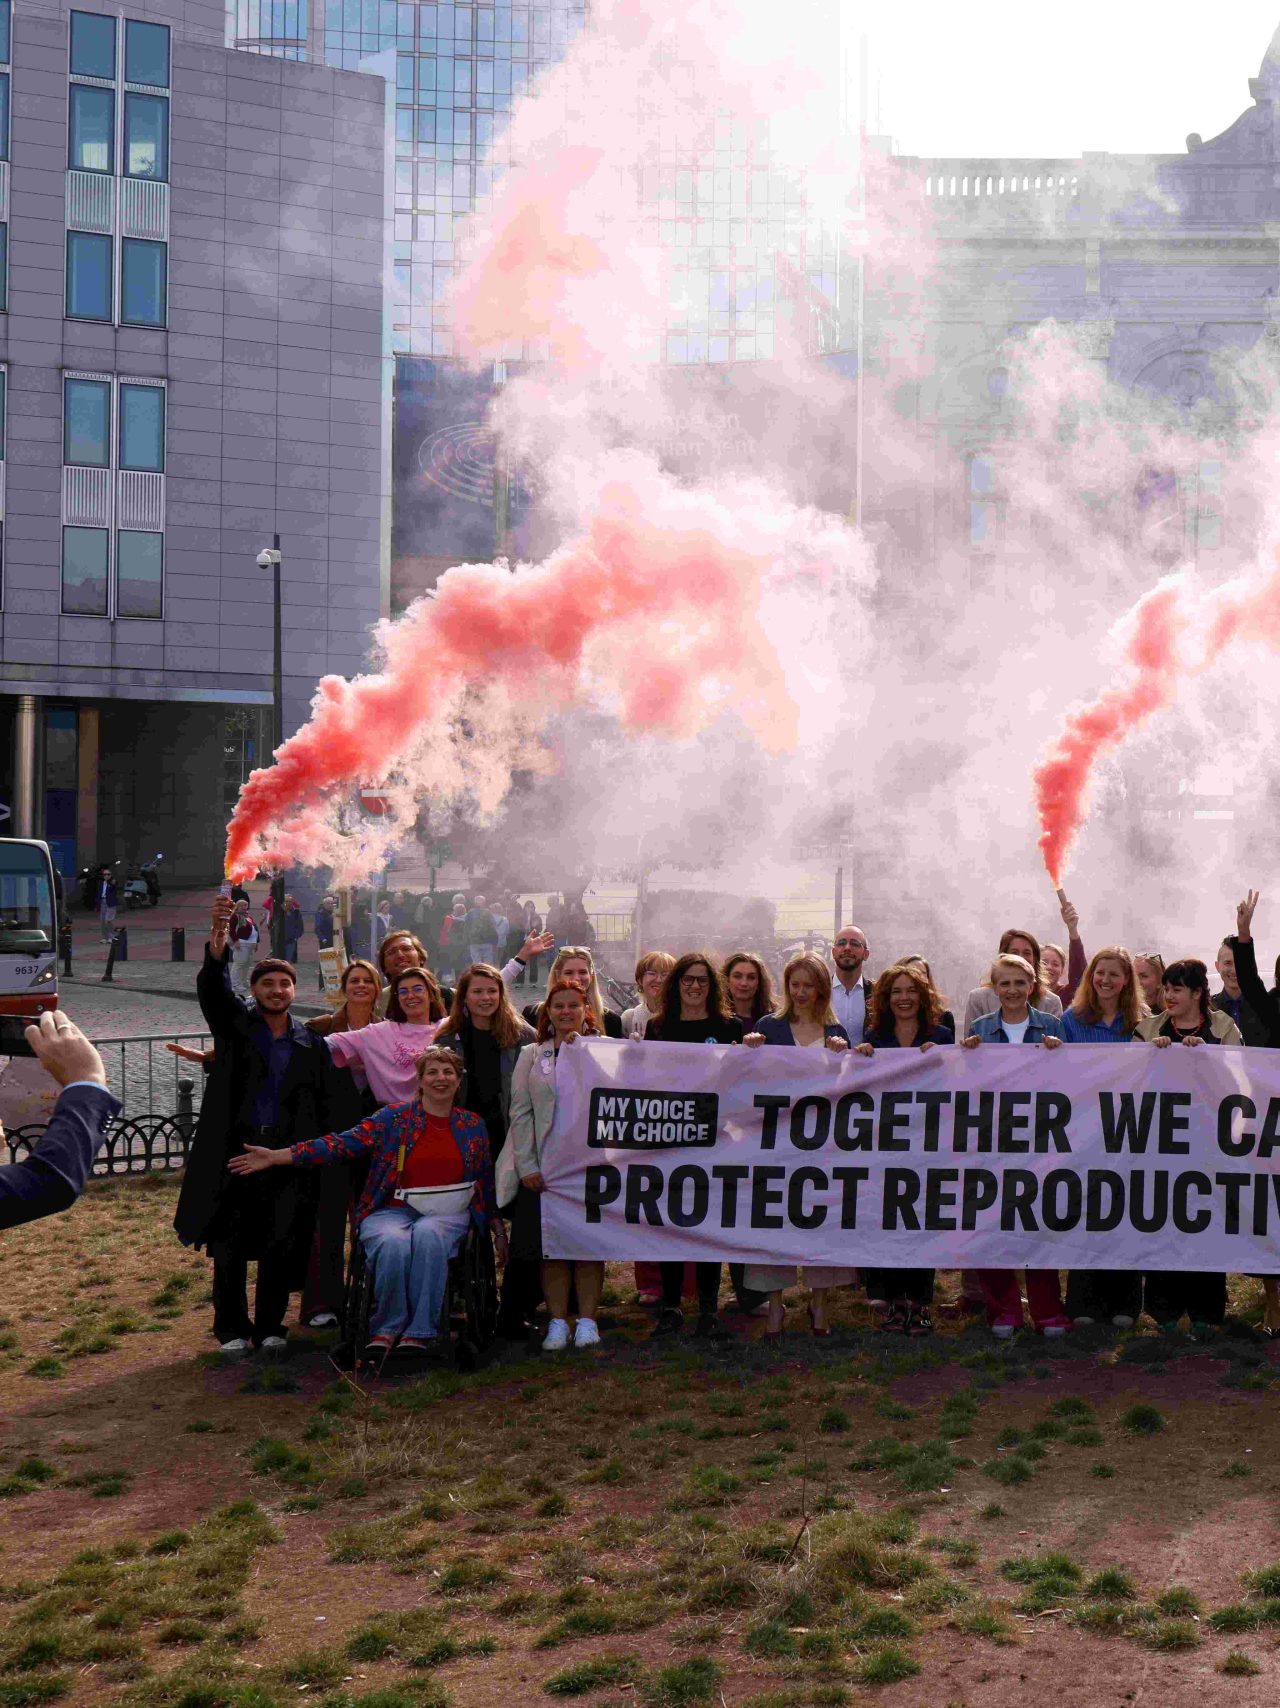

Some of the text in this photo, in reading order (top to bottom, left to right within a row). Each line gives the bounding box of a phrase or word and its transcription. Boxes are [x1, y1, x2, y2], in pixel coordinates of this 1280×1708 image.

[15, 965, 39, 976] 9637
[598, 1096, 696, 1121] MY VOICE
[596, 1119, 709, 1143] MY CHOICE
[753, 1091, 1073, 1153] TOGETHER
[1098, 1092, 1192, 1155] WE
[584, 1164, 869, 1230] PROTECT
